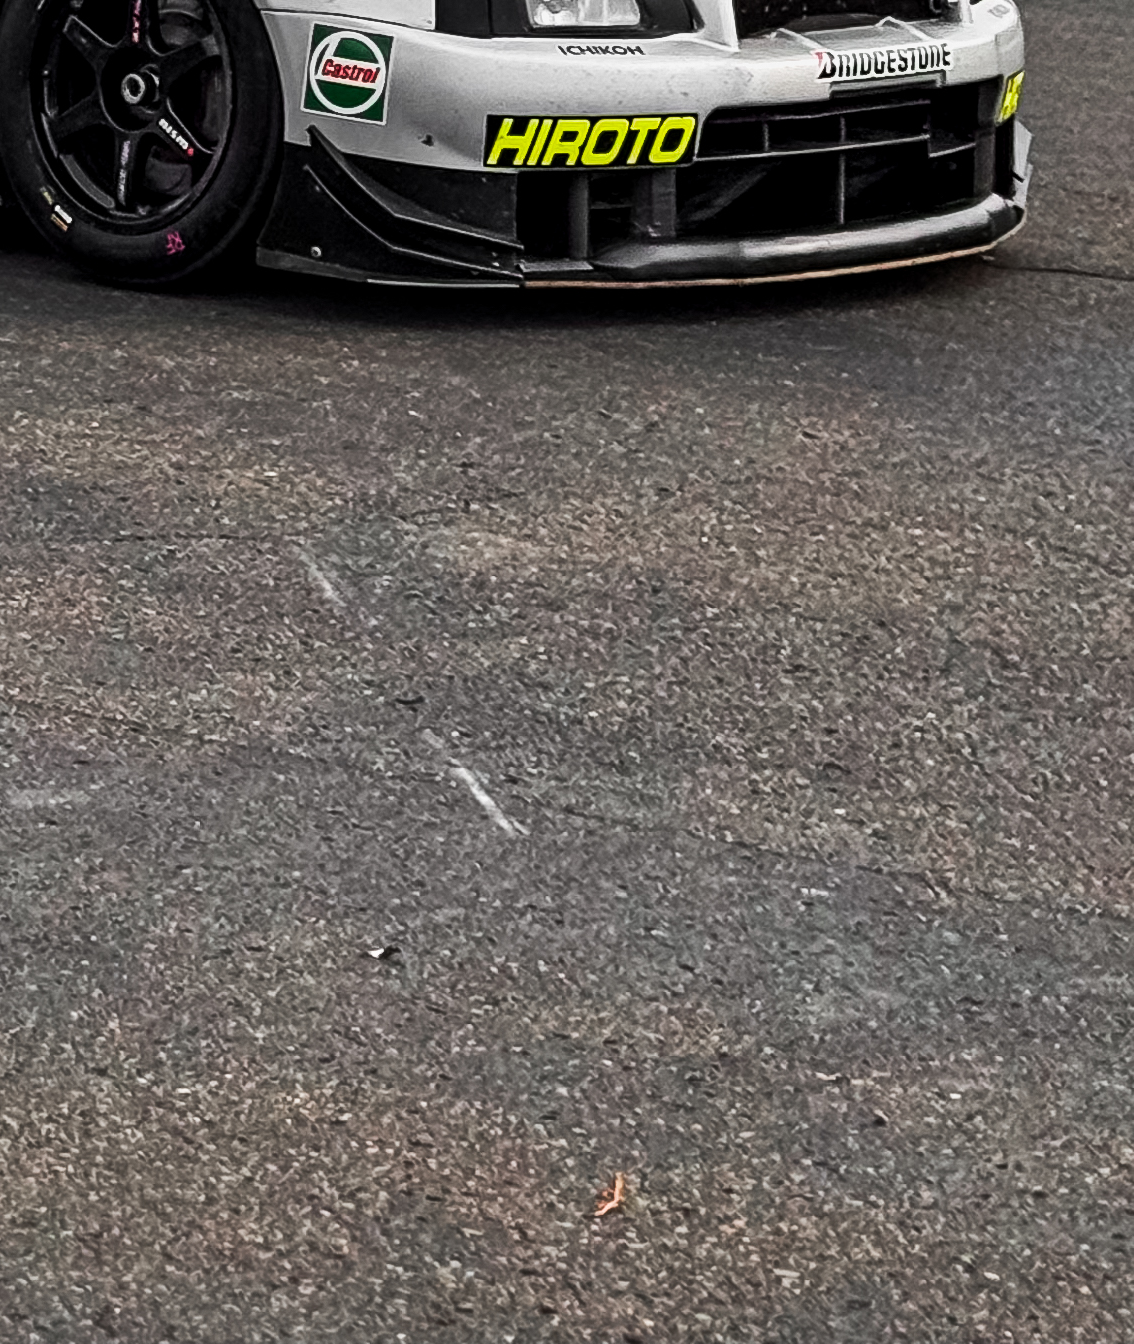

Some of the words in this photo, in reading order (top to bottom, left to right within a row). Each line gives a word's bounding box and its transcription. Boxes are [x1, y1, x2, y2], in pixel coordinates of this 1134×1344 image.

[557, 45, 646, 56] ICHIKOH
[813, 42, 952, 80] BRIDGESTONE
[321, 58, 382, 84] Castrol
[486, 116, 697, 166] HIROTO
